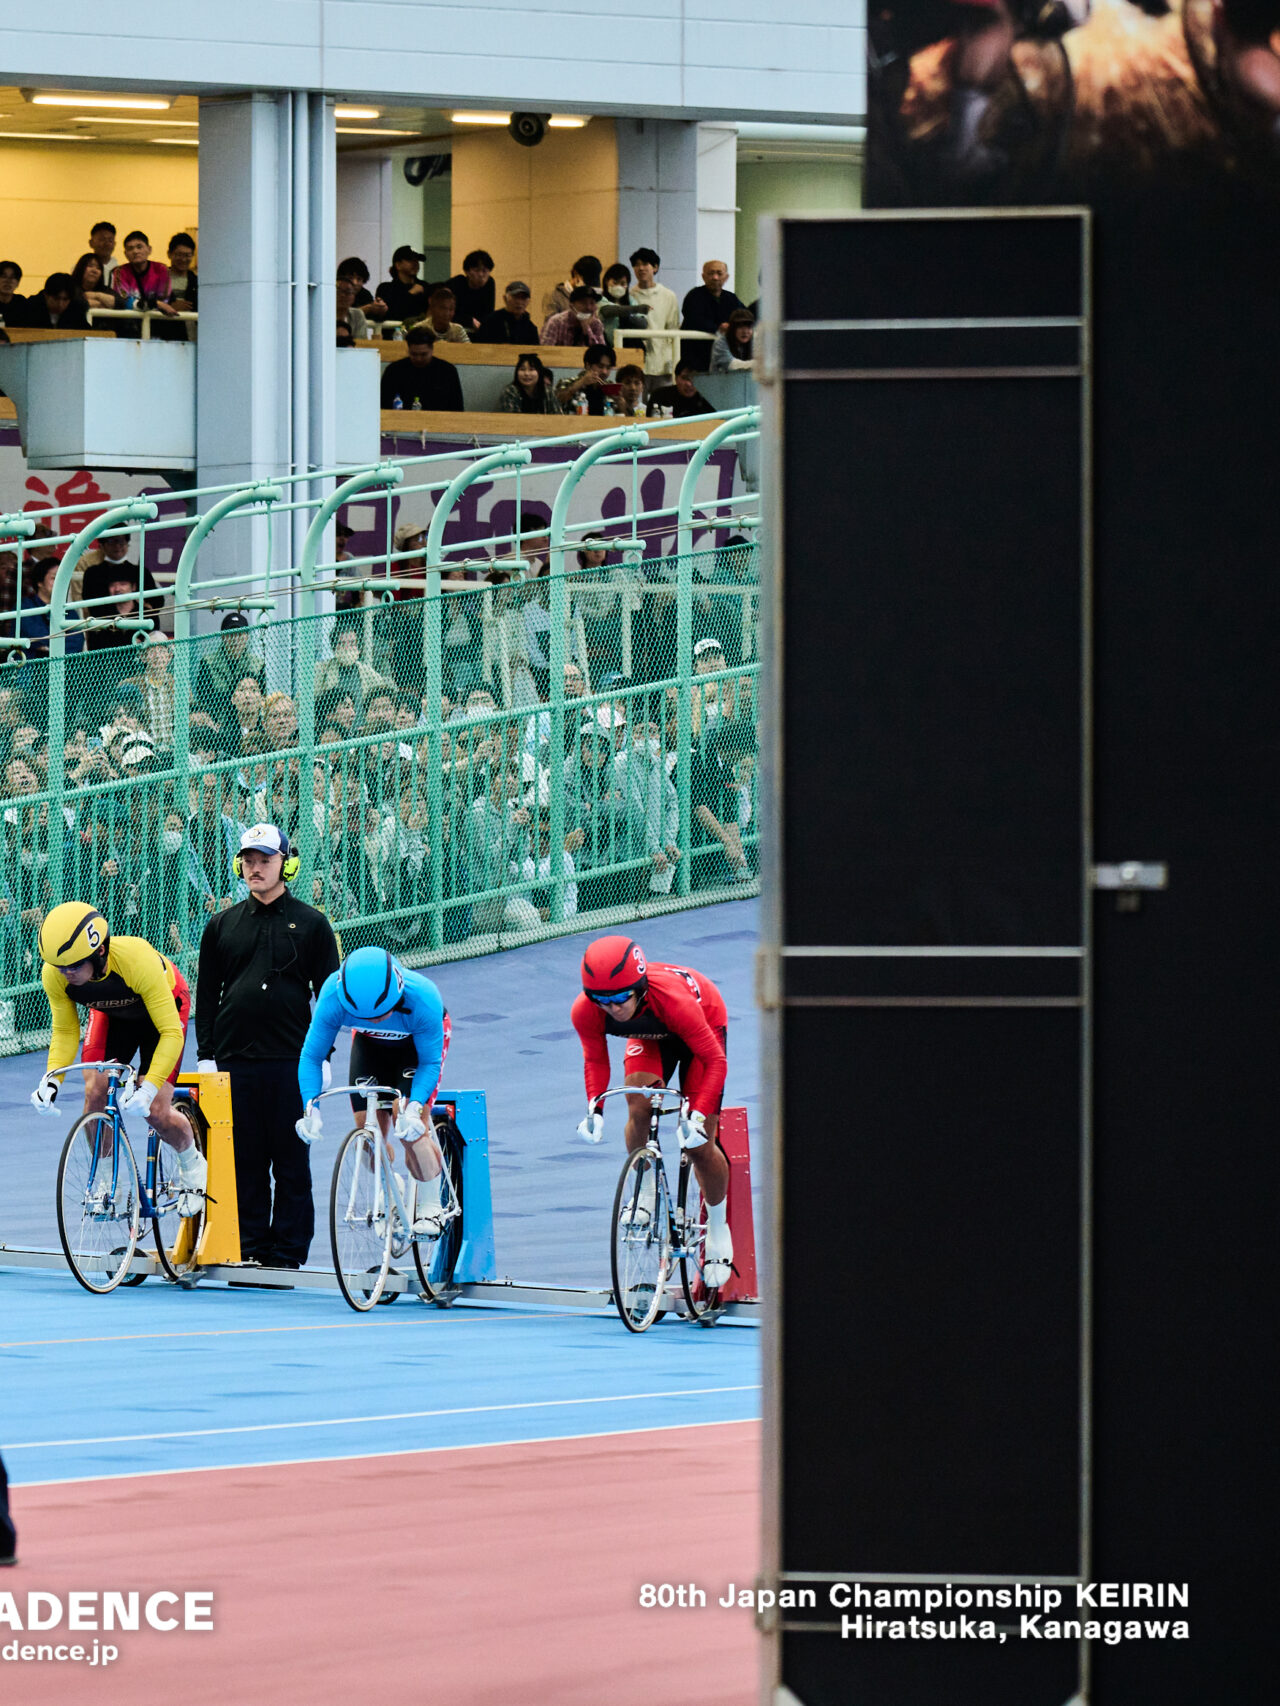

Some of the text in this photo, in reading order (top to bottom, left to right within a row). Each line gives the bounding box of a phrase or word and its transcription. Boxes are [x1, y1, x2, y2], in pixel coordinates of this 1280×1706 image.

[86, 922, 100, 949] 5
[632, 946, 647, 975] 3
[85, 997, 136, 1009] KEIRIN
